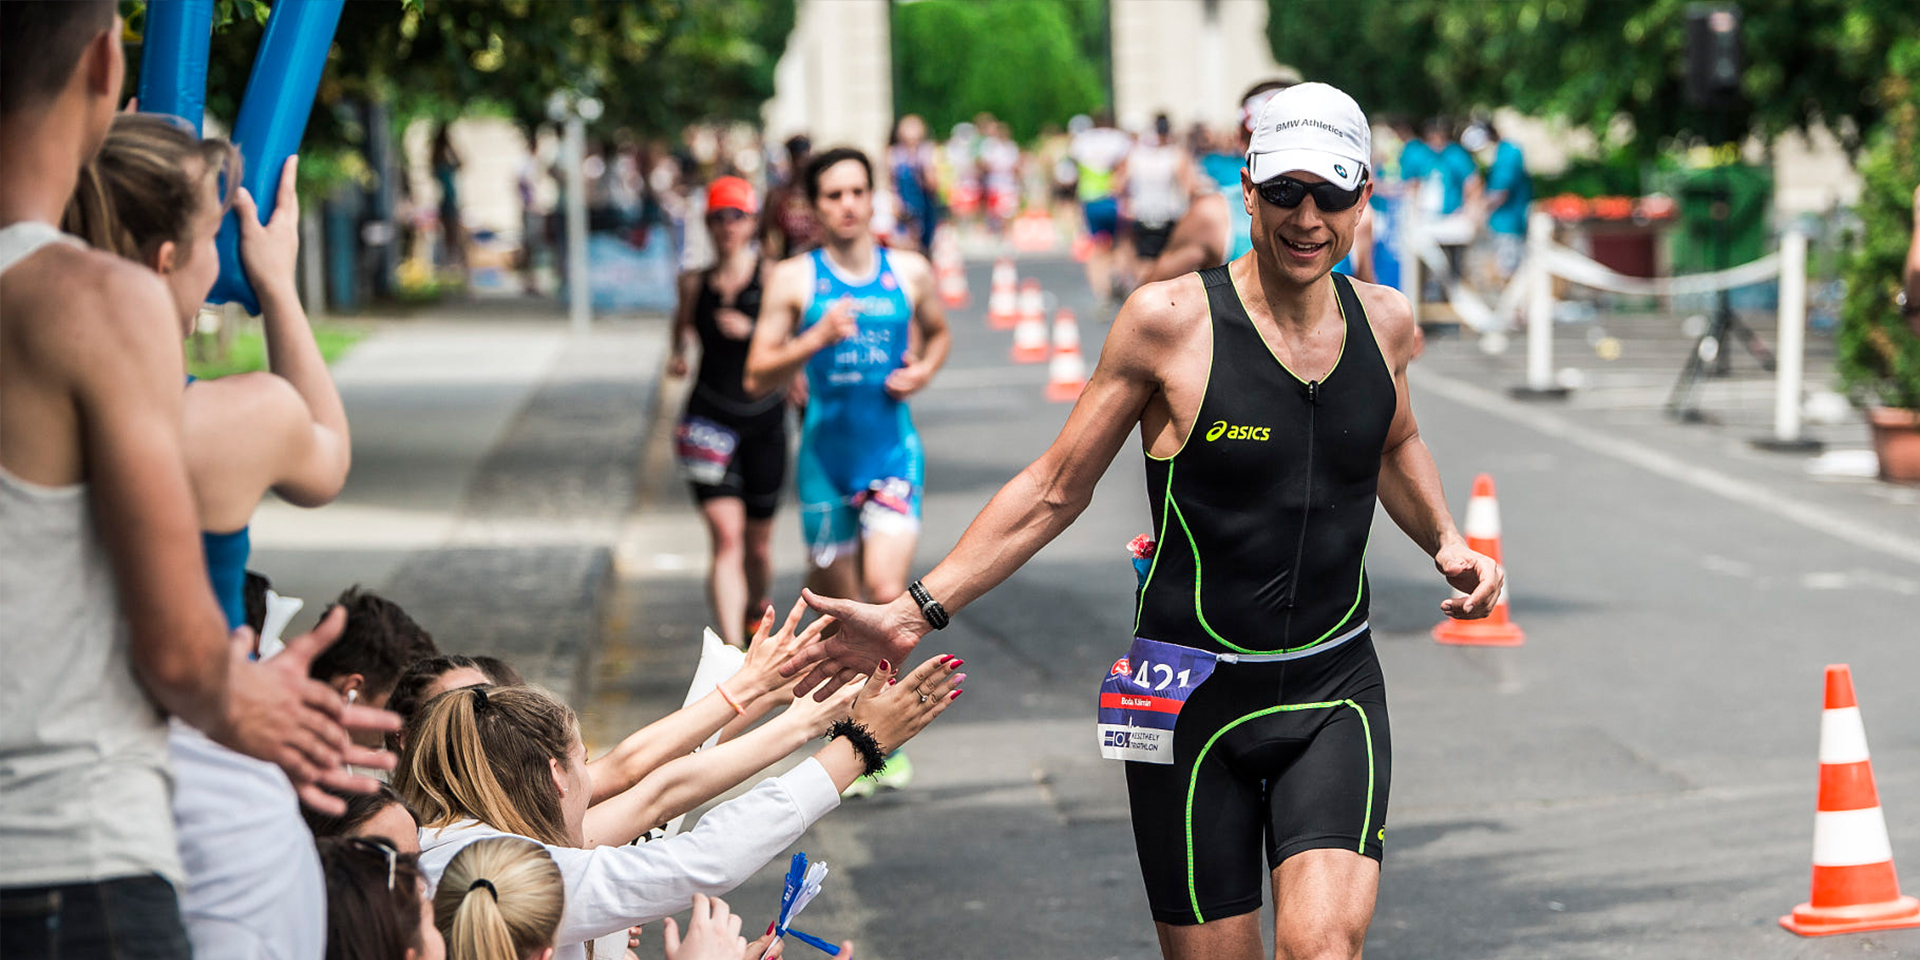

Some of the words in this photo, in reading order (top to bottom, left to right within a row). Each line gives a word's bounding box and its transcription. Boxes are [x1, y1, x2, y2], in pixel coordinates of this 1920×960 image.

[1275, 119, 1300, 133] BMW
[1301, 118, 1344, 138] Athletics
[1133, 660, 1191, 691] 421
